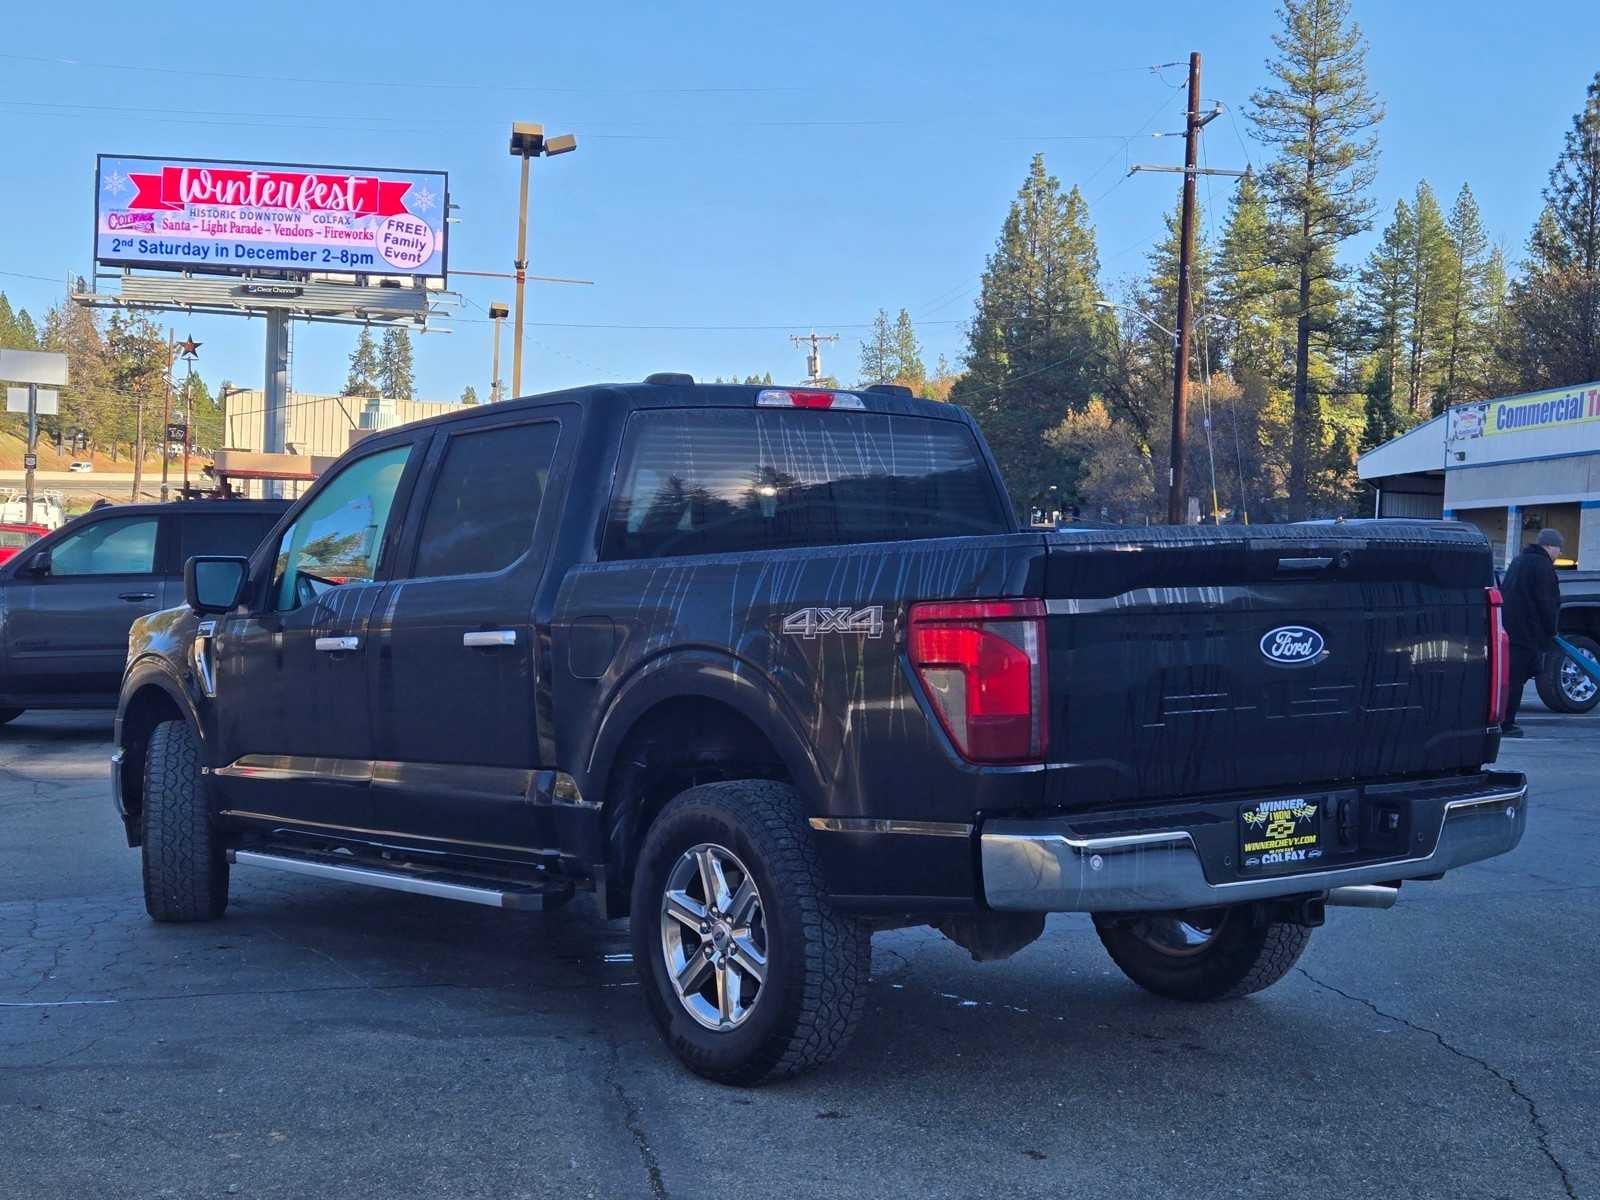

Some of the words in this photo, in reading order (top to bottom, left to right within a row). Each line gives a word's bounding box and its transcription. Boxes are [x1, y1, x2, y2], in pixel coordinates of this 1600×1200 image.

[179, 168, 366, 213] Winterfest
[189, 207, 236, 220] HISTORIC
[239, 210, 301, 223] DOWNTOWN
[312, 214, 351, 225] COLFAX
[161, 218, 191, 232] Santa
[201, 220, 228, 237] Light
[229, 221, 263, 235] Parade
[273, 223, 314, 238] Vendors
[324, 226, 374, 241] Fireworks
[387, 219, 427, 237] FREE!
[138, 240, 210, 259] Saturday
[215, 243, 229, 258] in
[234, 244, 317, 263] December
[383, 233, 426, 252] Family
[384, 246, 422, 263] Event
[1496, 391, 1585, 430] Commercial
[1272, 631, 1313, 656] Ford
[1260, 799, 1304, 812] WINNER
[1262, 850, 1305, 864] COLFAX
